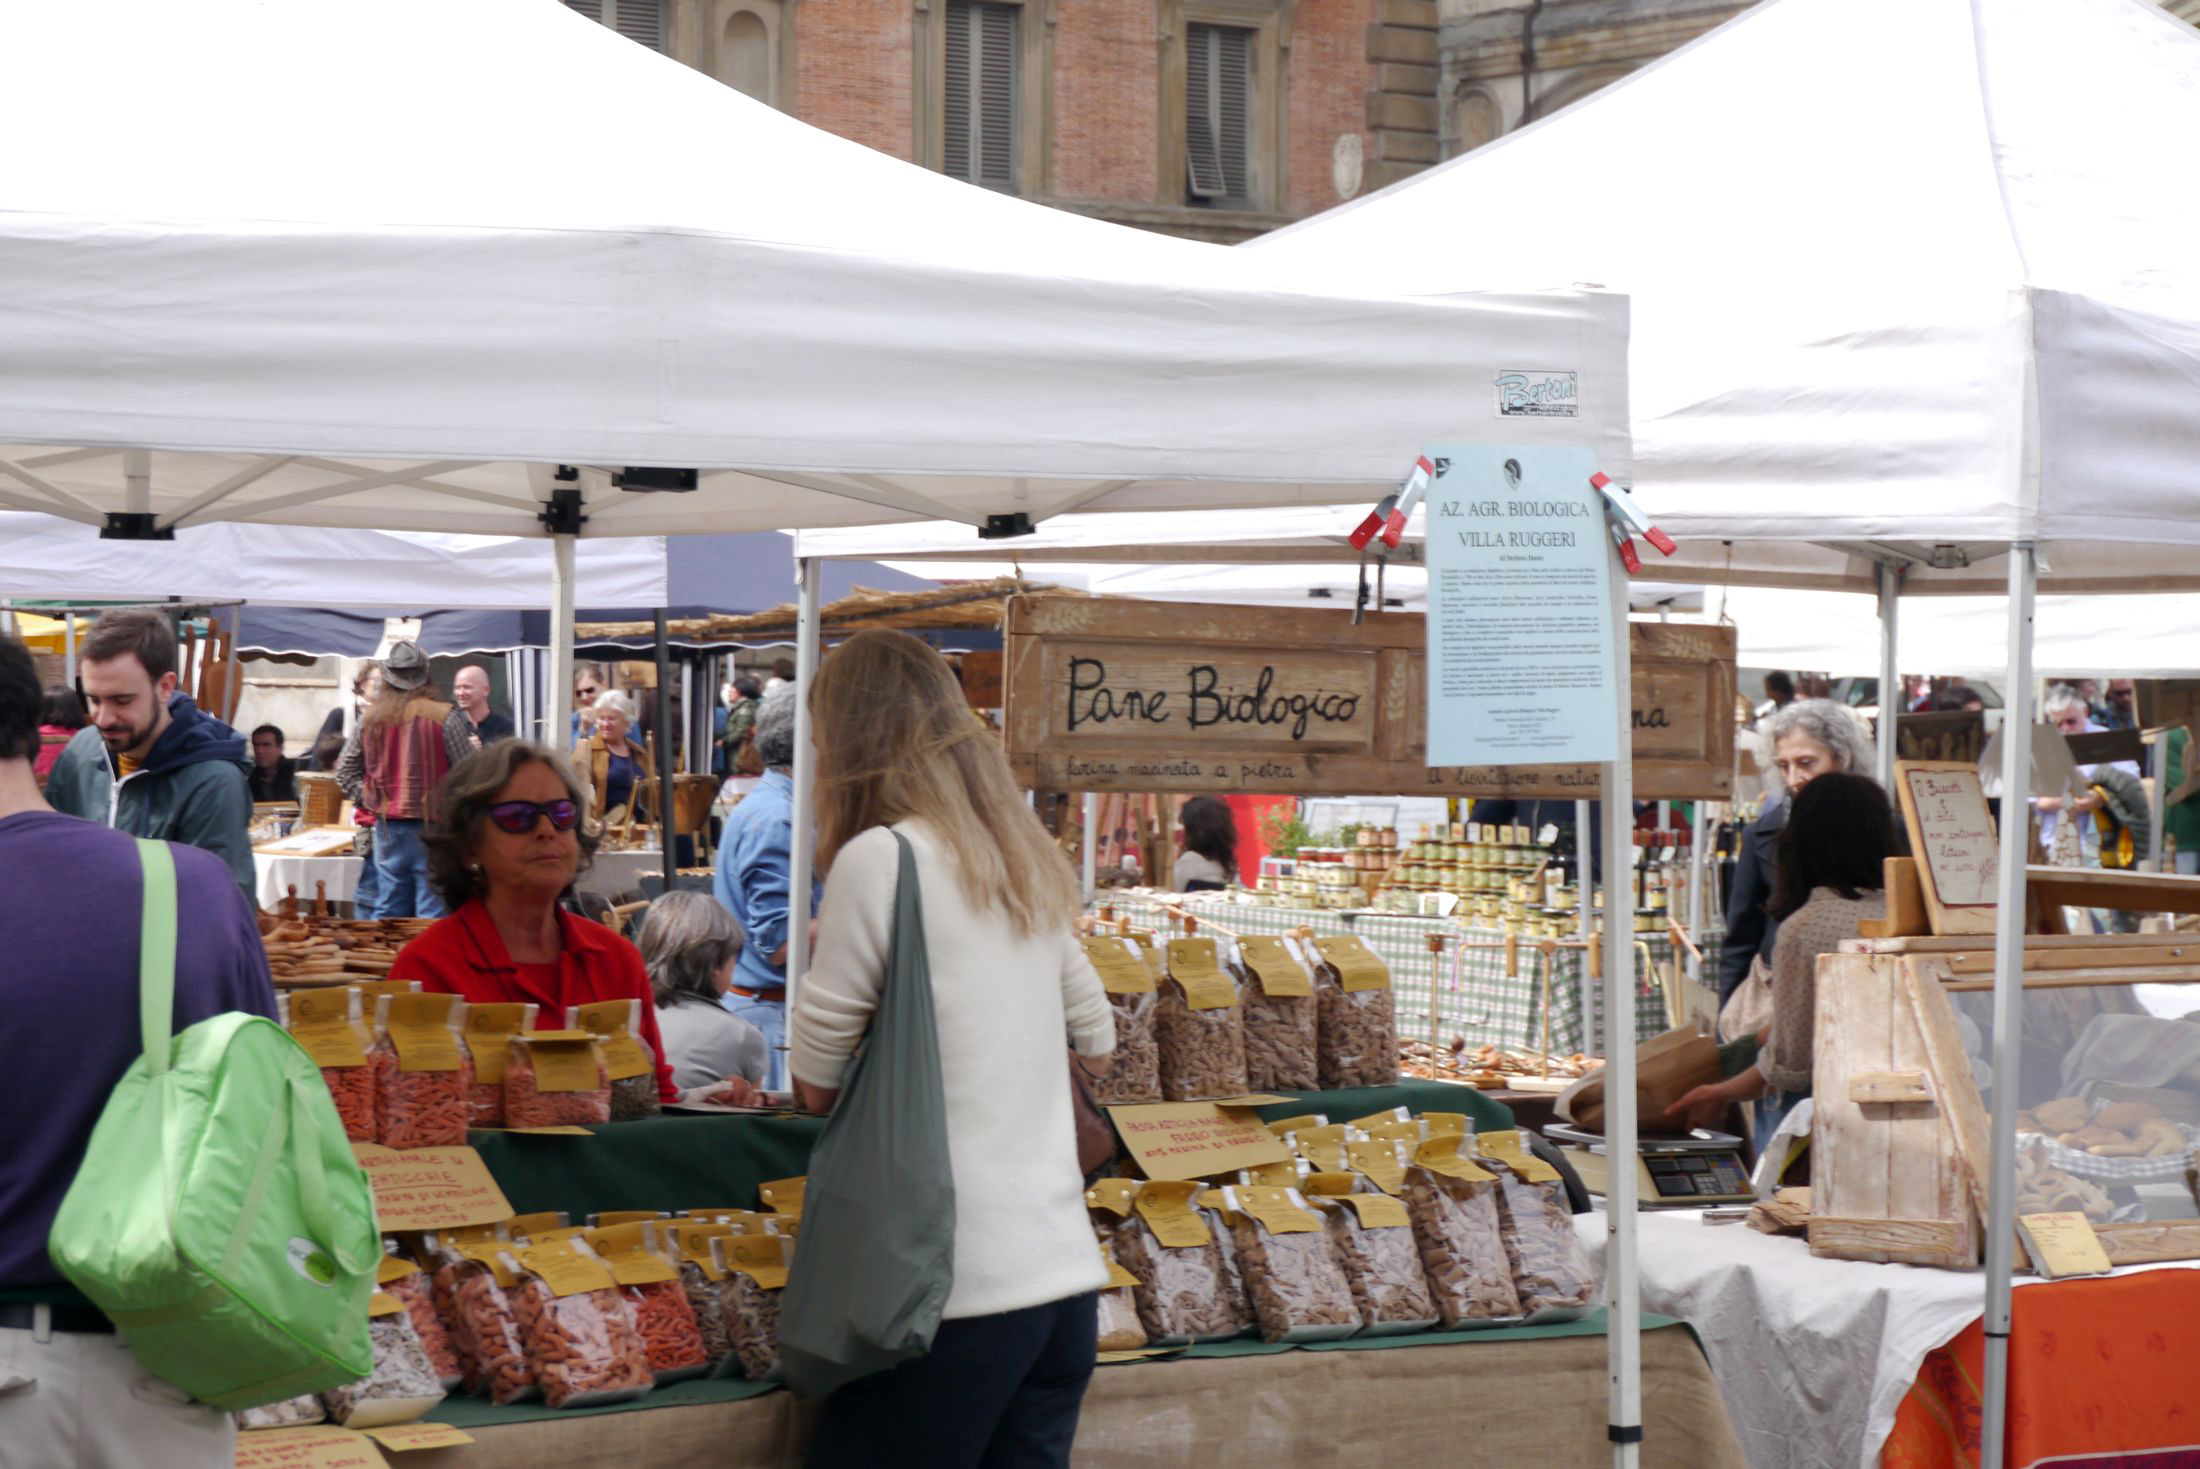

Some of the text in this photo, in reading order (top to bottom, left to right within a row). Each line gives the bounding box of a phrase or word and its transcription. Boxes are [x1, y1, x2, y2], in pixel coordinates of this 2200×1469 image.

[1440, 501, 1590, 517] AZ. AGR. BIOLOGICA
[1458, 532, 1576, 547] VILLA RUGGERI
[1068, 656, 1170, 731] Pane
[1188, 665, 1361, 740] Biologico
[1214, 764, 1228, 777] a
[1241, 761, 1296, 786] pietra
[371, 1171, 457, 1187] ENTICCHIE
